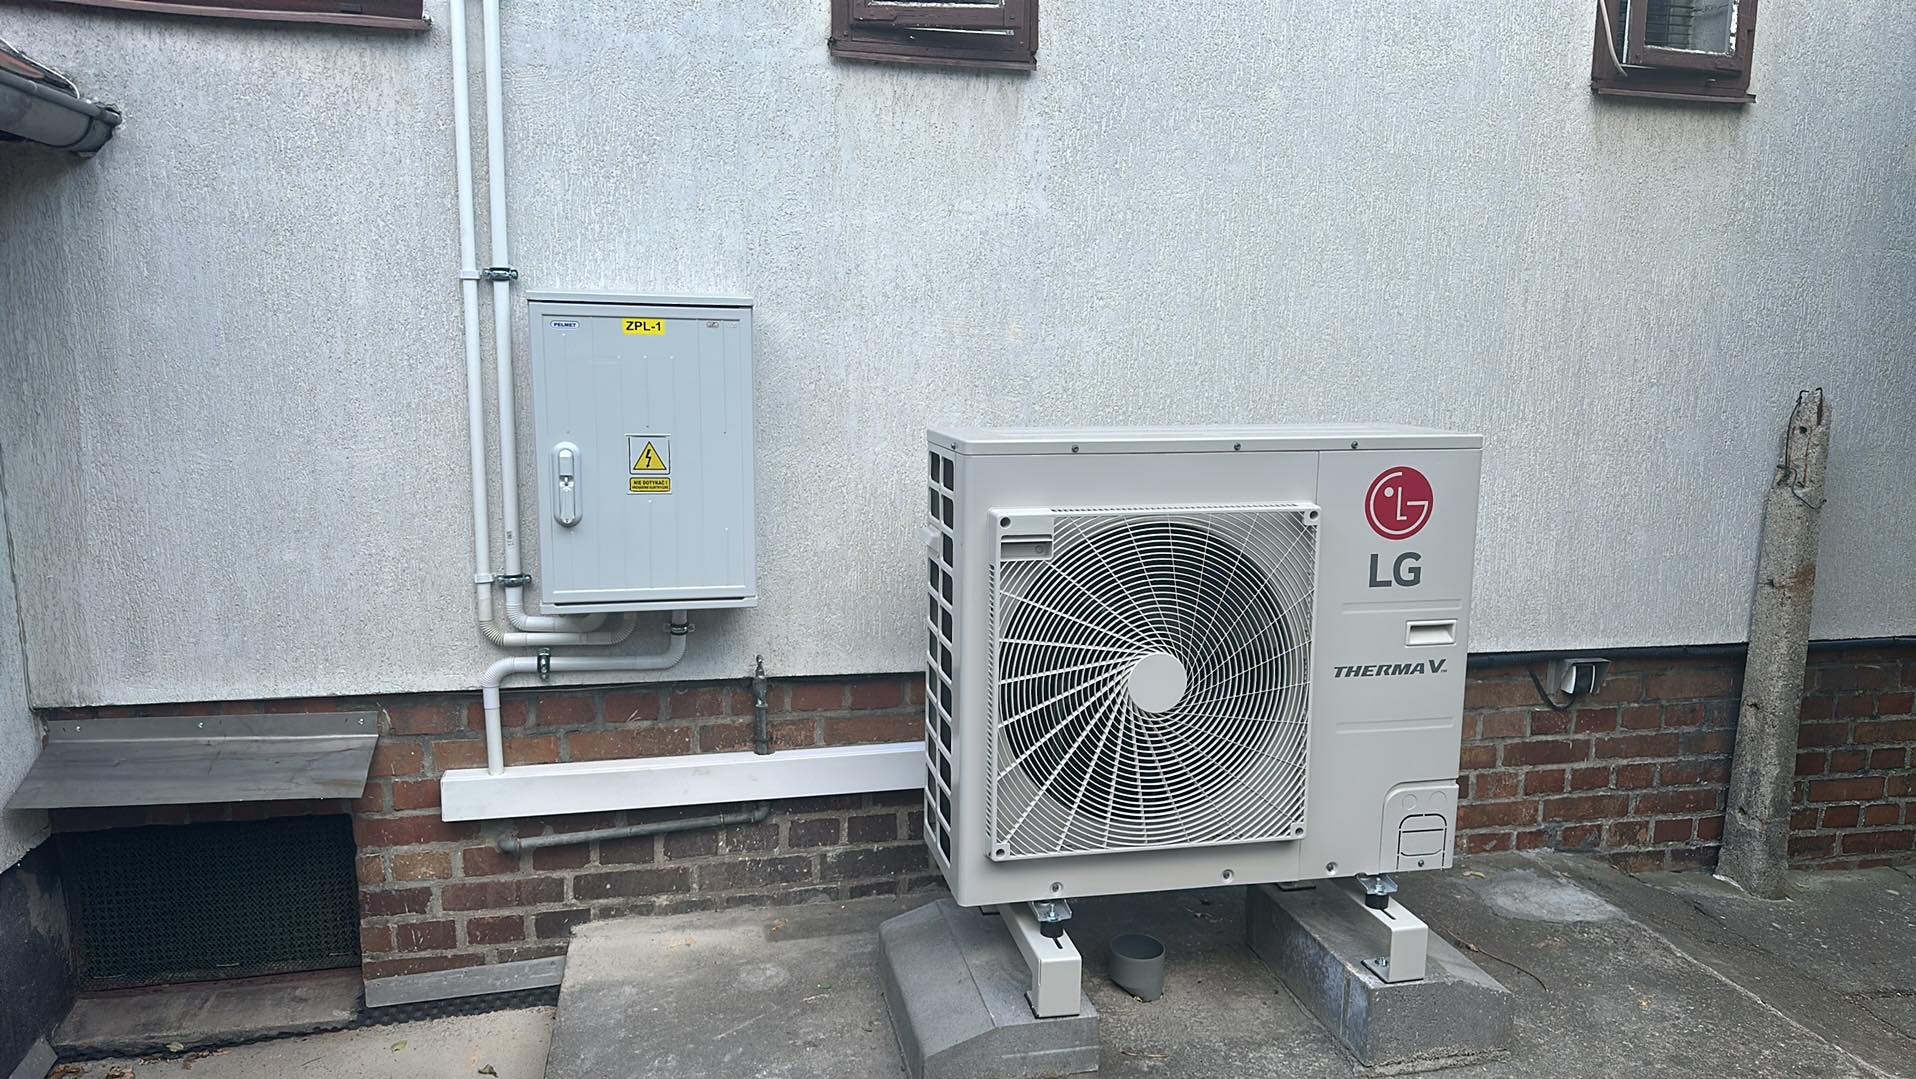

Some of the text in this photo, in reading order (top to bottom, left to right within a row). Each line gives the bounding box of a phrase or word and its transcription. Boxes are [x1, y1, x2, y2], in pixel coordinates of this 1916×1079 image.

[625, 320, 662, 332] ZPL-1
[1368, 551, 1422, 588] LG
[1334, 662, 1425, 678] THERMA
